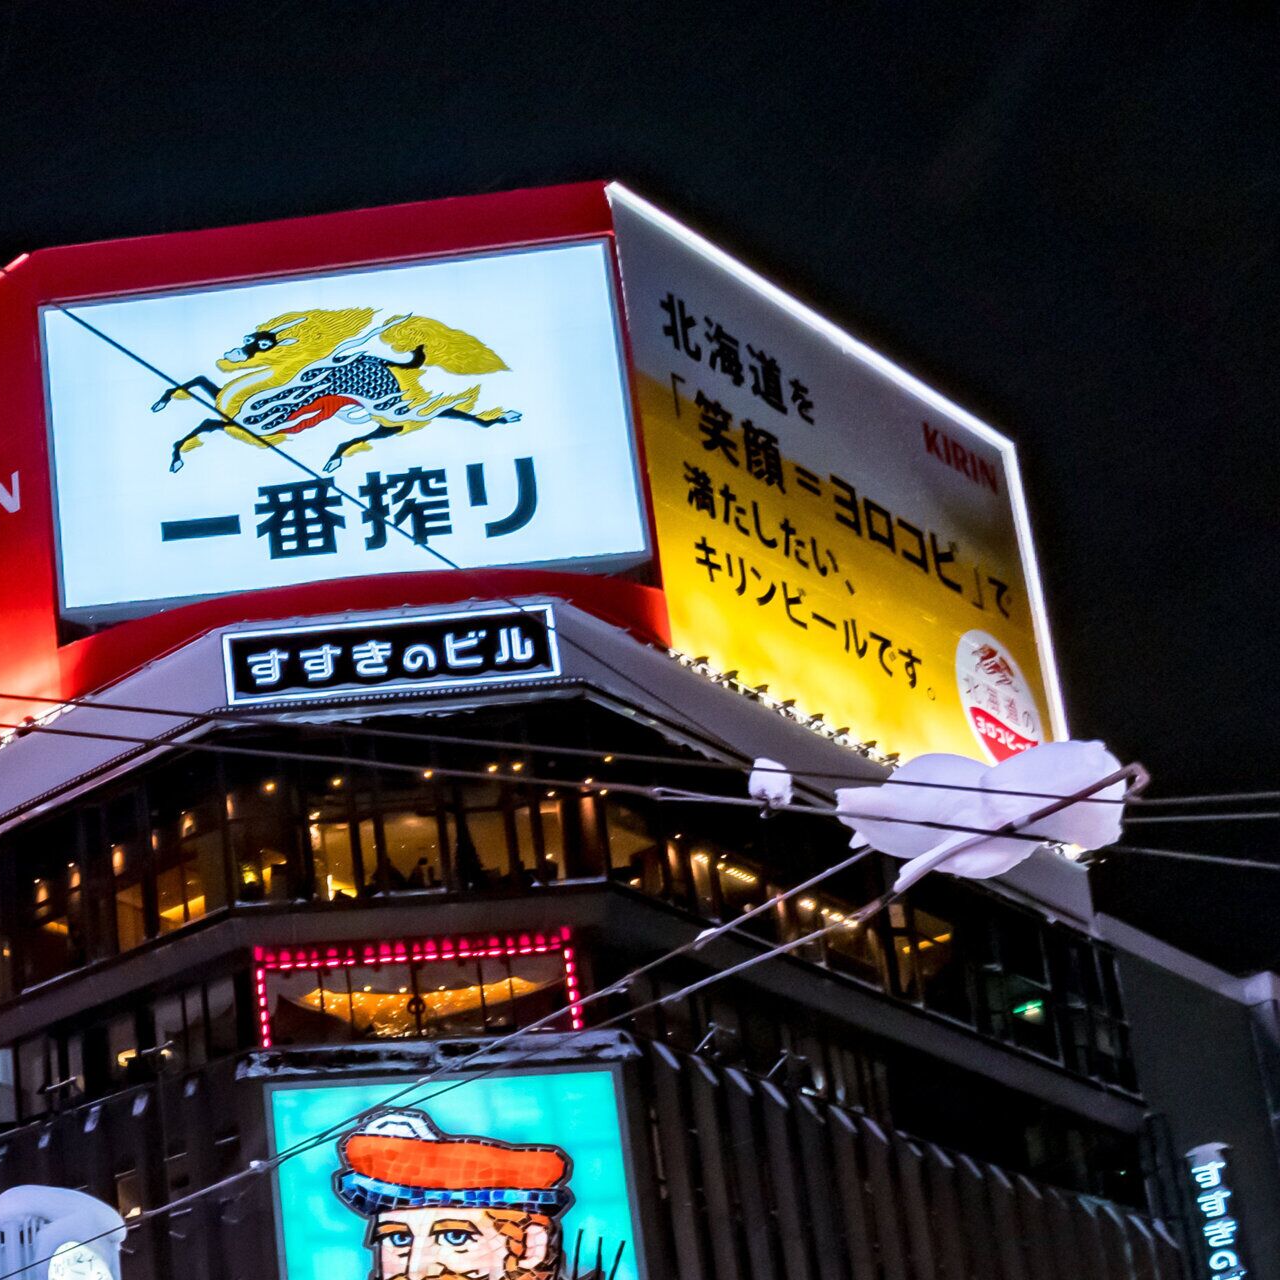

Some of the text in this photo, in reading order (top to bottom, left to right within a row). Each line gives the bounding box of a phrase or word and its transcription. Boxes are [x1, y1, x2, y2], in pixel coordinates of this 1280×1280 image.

[659, 292, 814, 424] 北海道を
[160, 456, 539, 561] 一番搾り
[922, 421, 998, 494] KIRIN
[247, 628, 534, 686] すすきのビル
[695, 538, 936, 701] キリンビールです。
